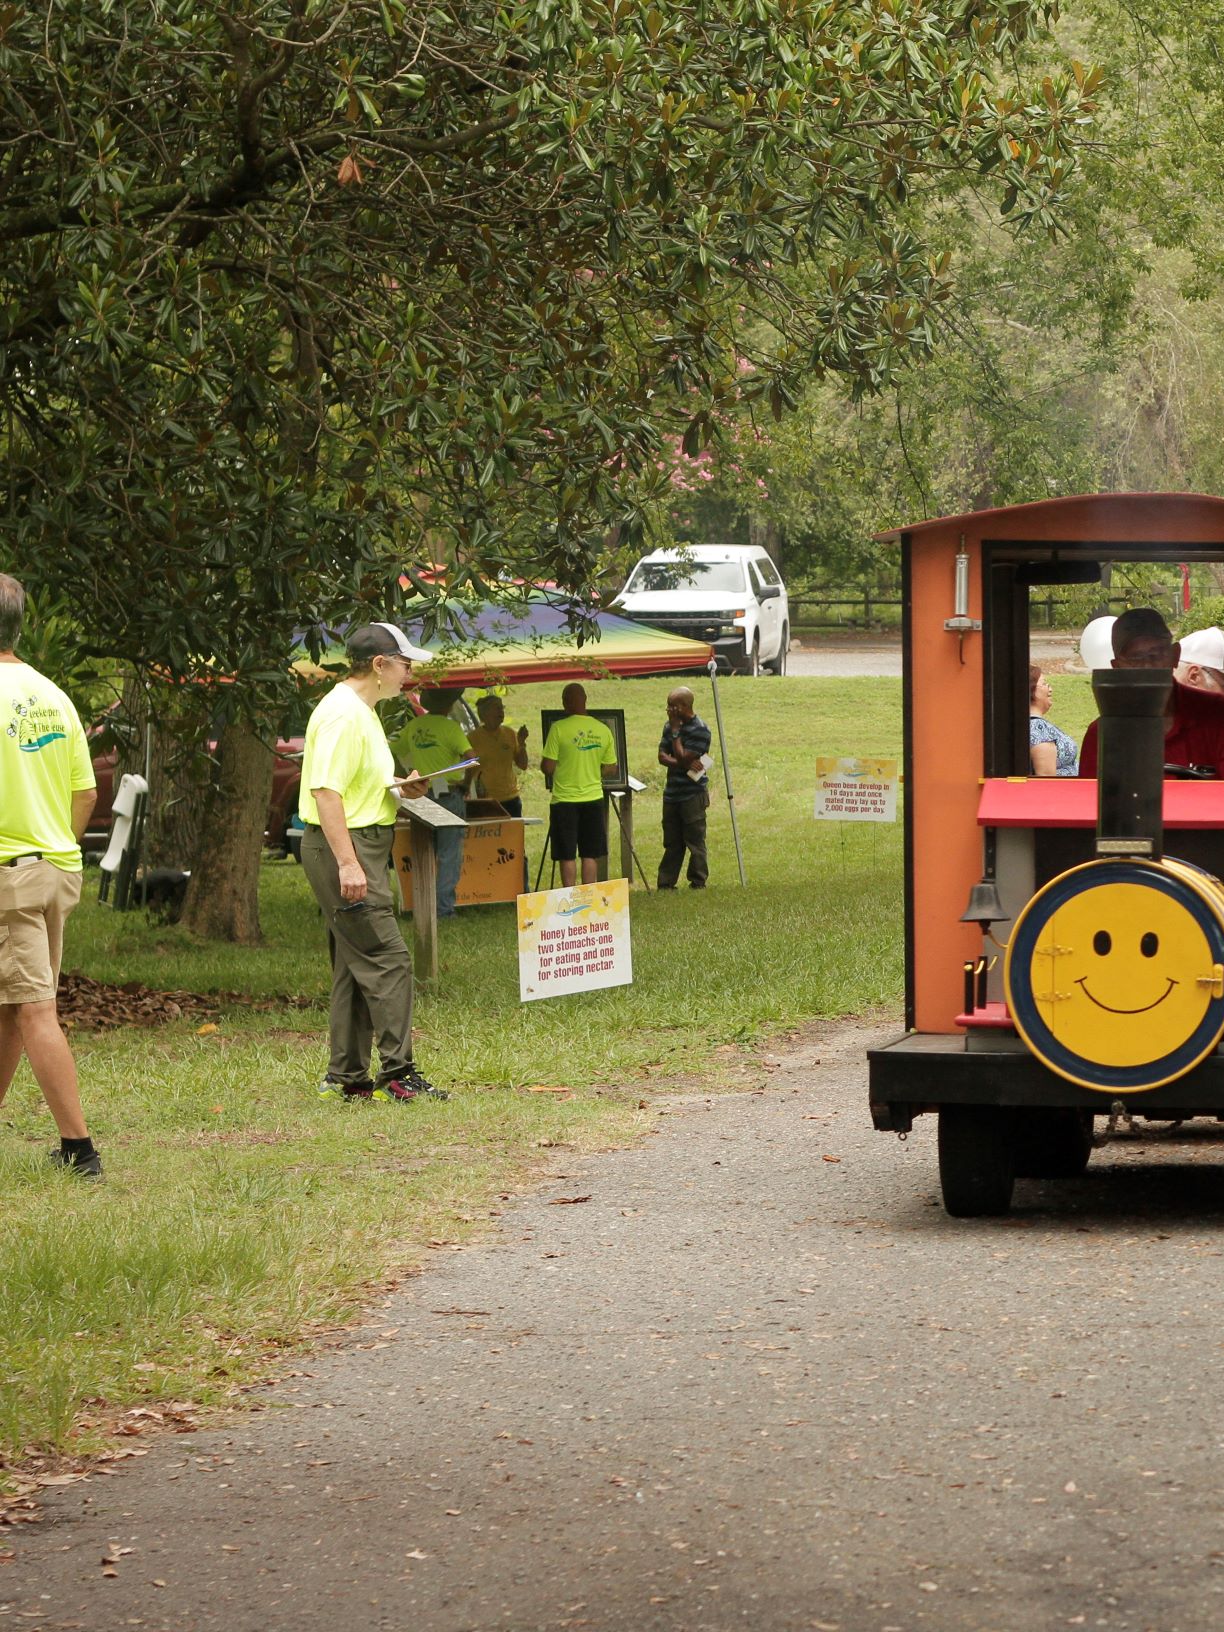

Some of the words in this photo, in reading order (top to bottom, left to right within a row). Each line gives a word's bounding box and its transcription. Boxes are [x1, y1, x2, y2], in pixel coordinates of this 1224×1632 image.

[823, 781, 842, 789] Queen
[474, 824, 502, 839] Bred
[540, 929, 565, 941] Honey
[568, 925, 587, 936] bees
[590, 921, 609, 933] have
[538, 944, 554, 955] two
[557, 933, 613, 952] stomachs-one
[540, 956, 552, 968] for
[555, 951, 581, 966] eating
[583, 948, 598, 960] and
[600, 946, 614, 957] one
[538, 970, 551, 981] for
[553, 964, 584, 979] storing
[586, 960, 615, 973] nectar.
